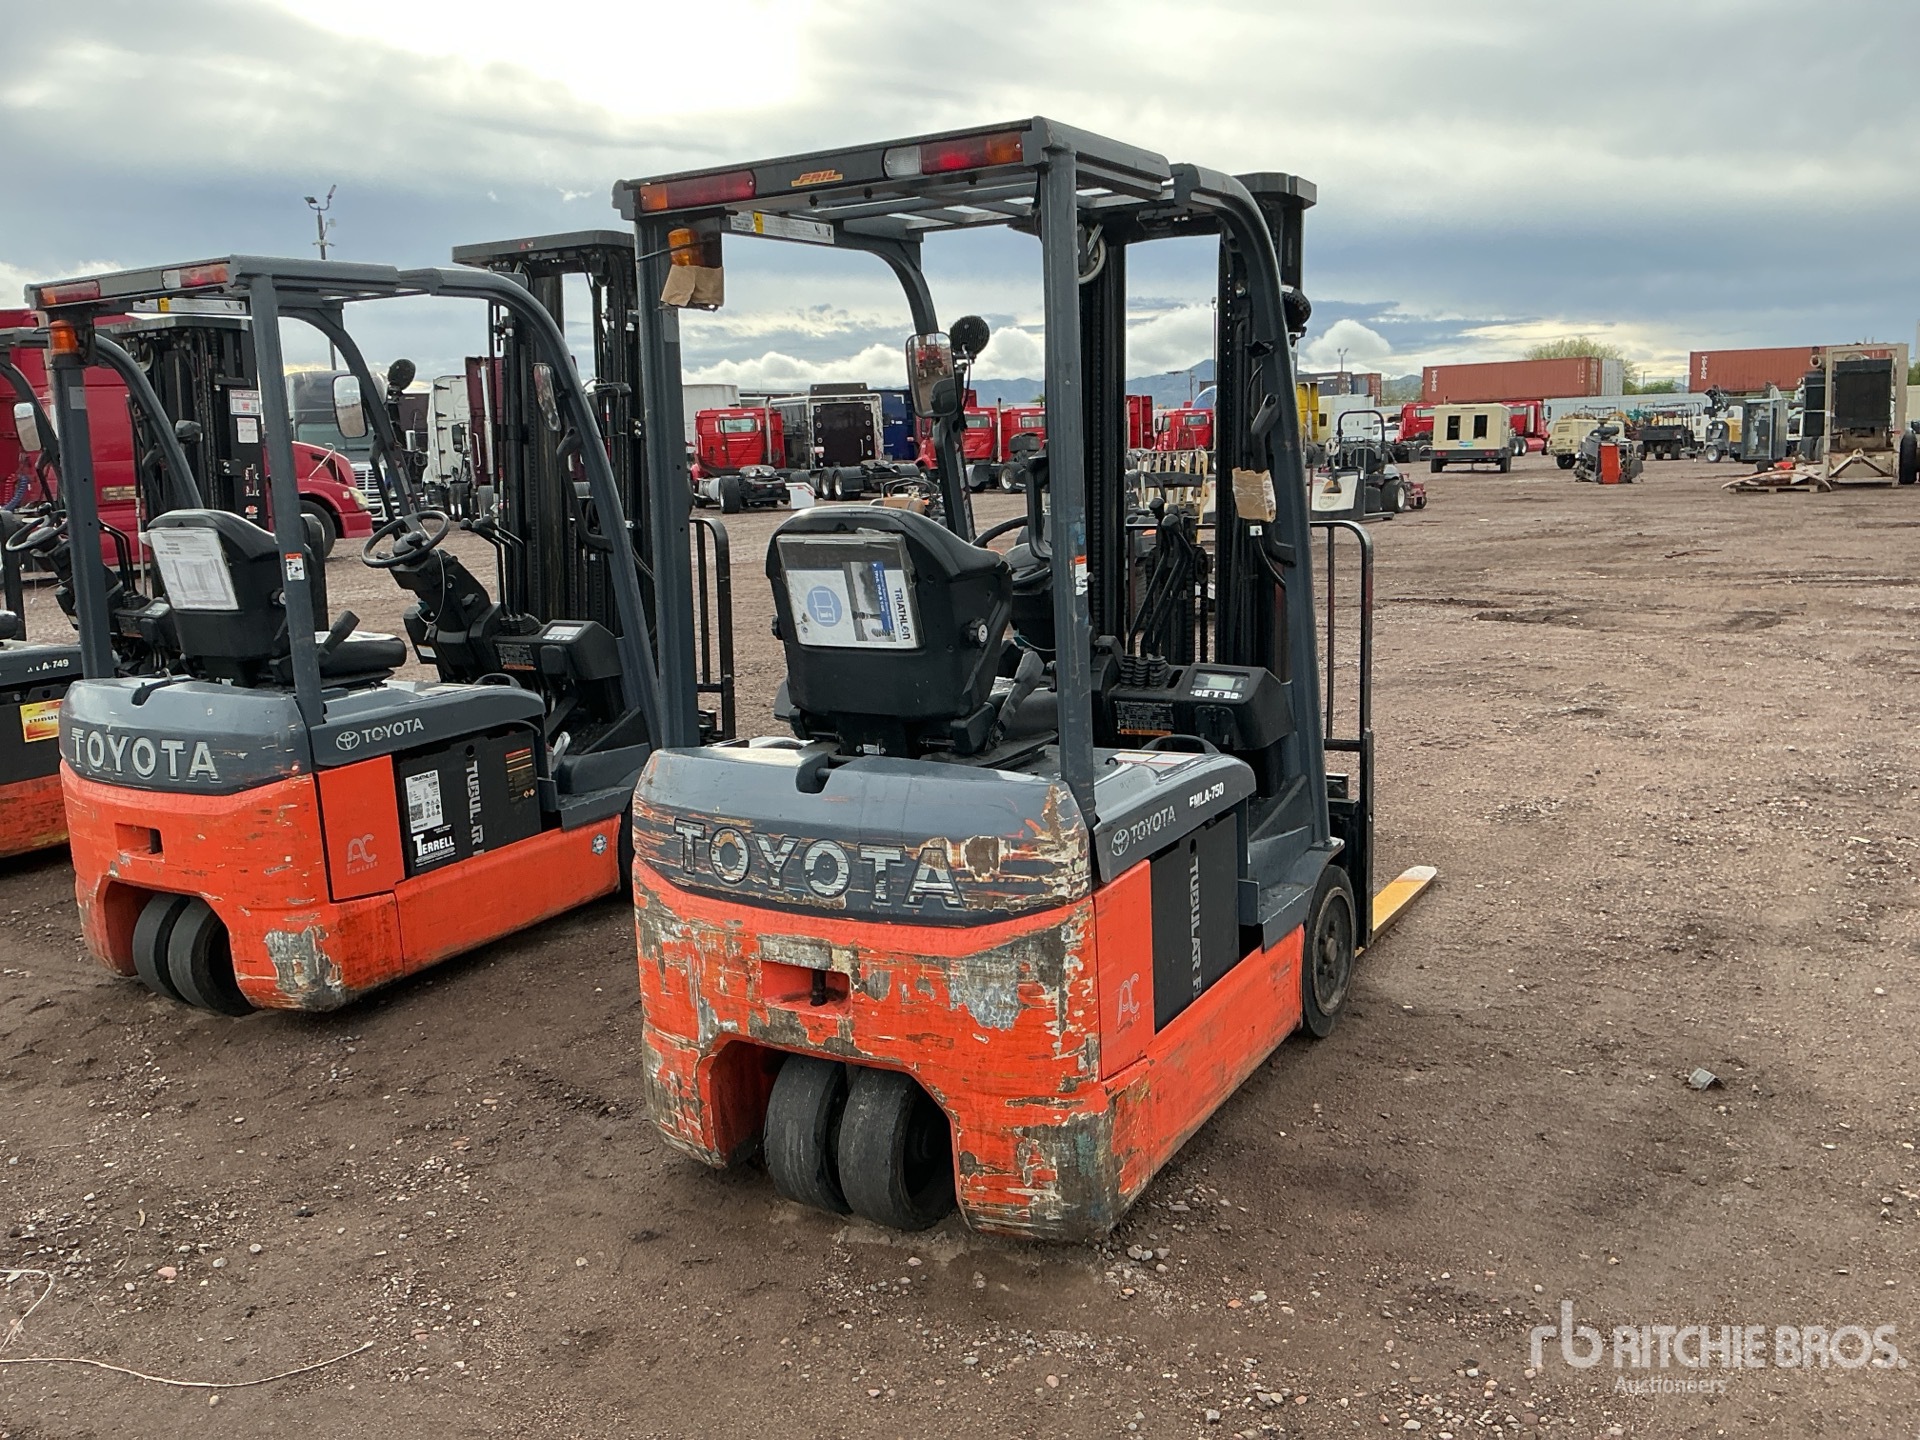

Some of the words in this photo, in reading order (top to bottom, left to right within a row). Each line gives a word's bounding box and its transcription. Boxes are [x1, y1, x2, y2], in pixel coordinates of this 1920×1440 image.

[361, 718, 425, 743] TOYOTA
[71, 727, 223, 783] TOYOTA
[412, 833, 455, 857] TERRELL
[1130, 805, 1176, 844] TOYOTA
[674, 818, 967, 911] TOYOTA
[1189, 857, 1202, 971] TUBULAR
